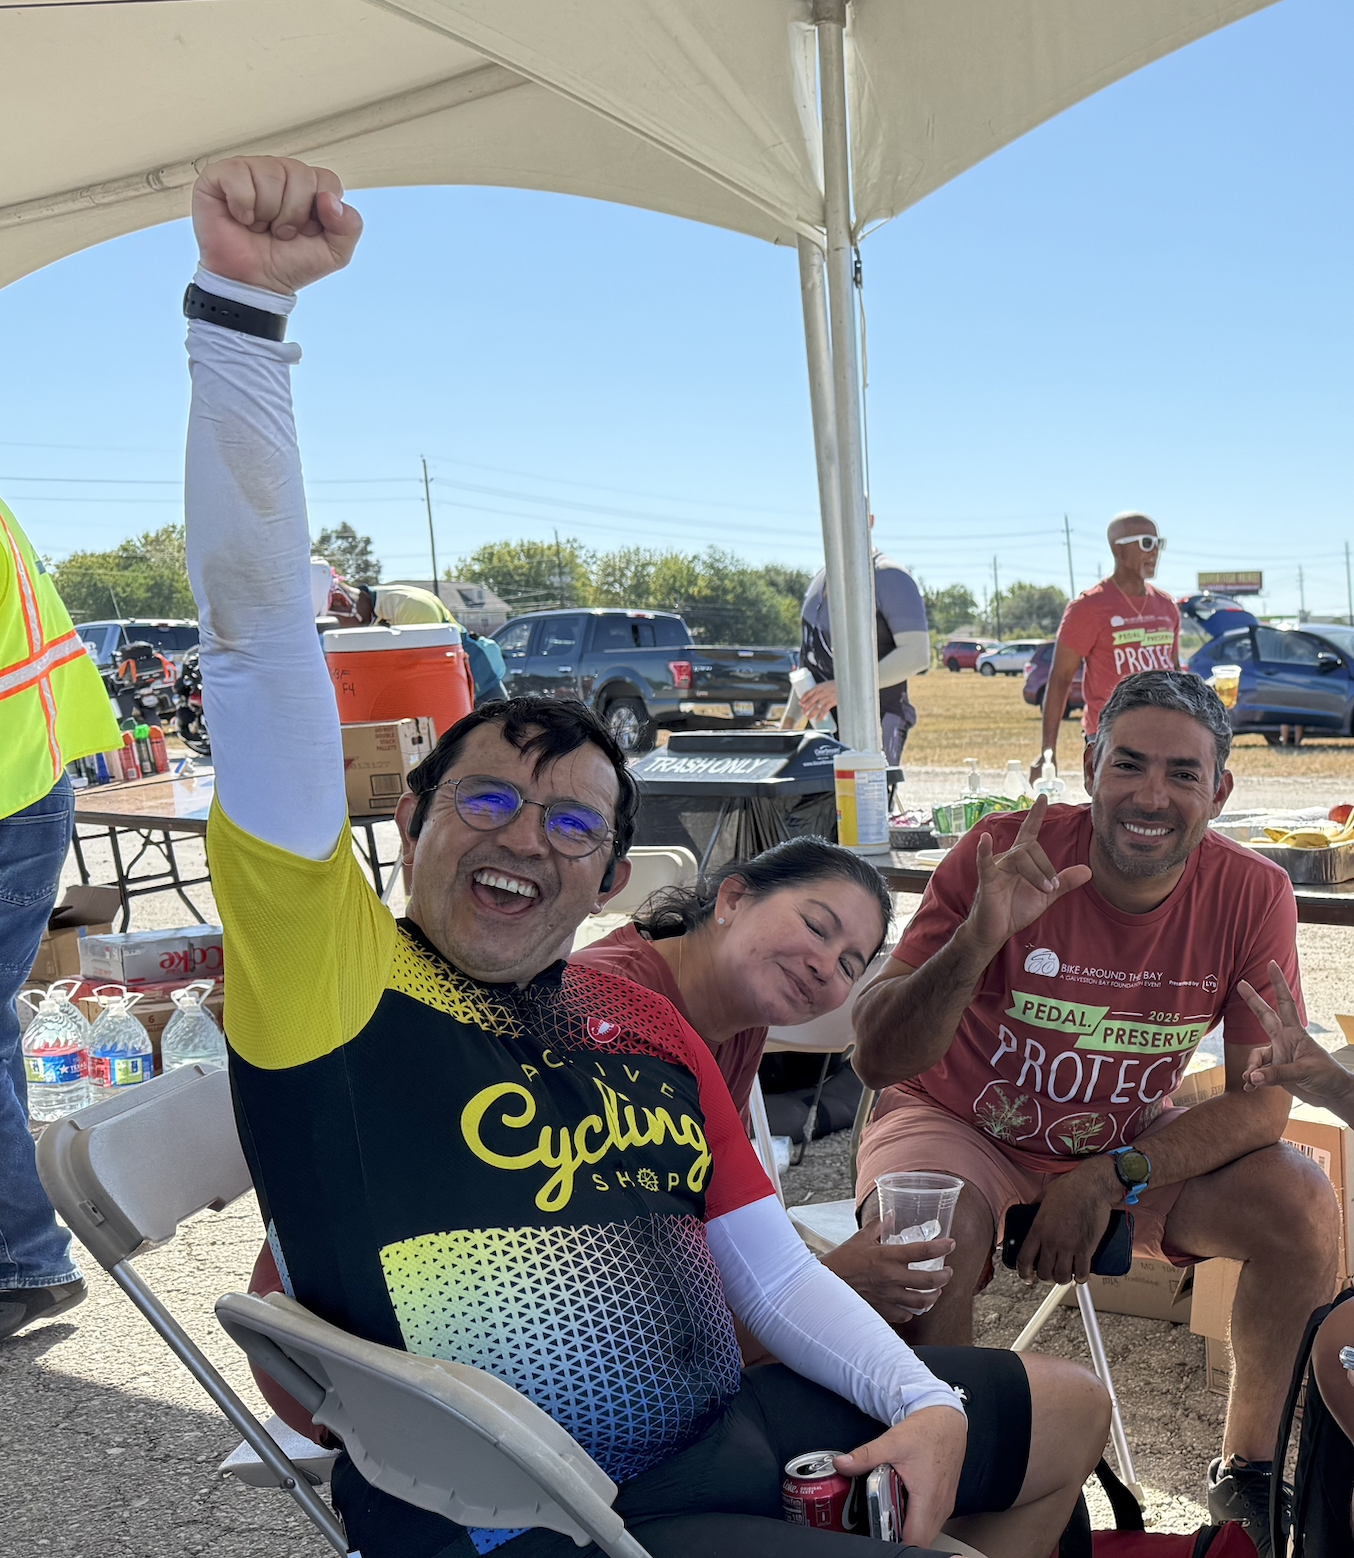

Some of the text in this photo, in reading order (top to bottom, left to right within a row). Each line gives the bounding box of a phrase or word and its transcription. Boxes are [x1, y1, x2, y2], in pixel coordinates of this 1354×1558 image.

[342, 682, 356, 697] F4
[643, 757, 768, 775] TRASH ONLY
[1061, 963, 1164, 982] BIKE AROUND THE BAY
[1065, 975, 1098, 986] GALVESTON
[1110, 980, 1143, 989] FOUNDATION
[1144, 980, 1162, 988] EVENT
[1190, 980, 1199, 988] by
[148, 1014, 155, 1024] 6
[1021, 999, 1093, 1028] PEDAL.
[1148, 1010, 1181, 1023] 2025
[521, 1049, 675, 1099] ACIVE
[460, 1077, 712, 1212] Cycling
[592, 1167, 680, 1193] SHOP
